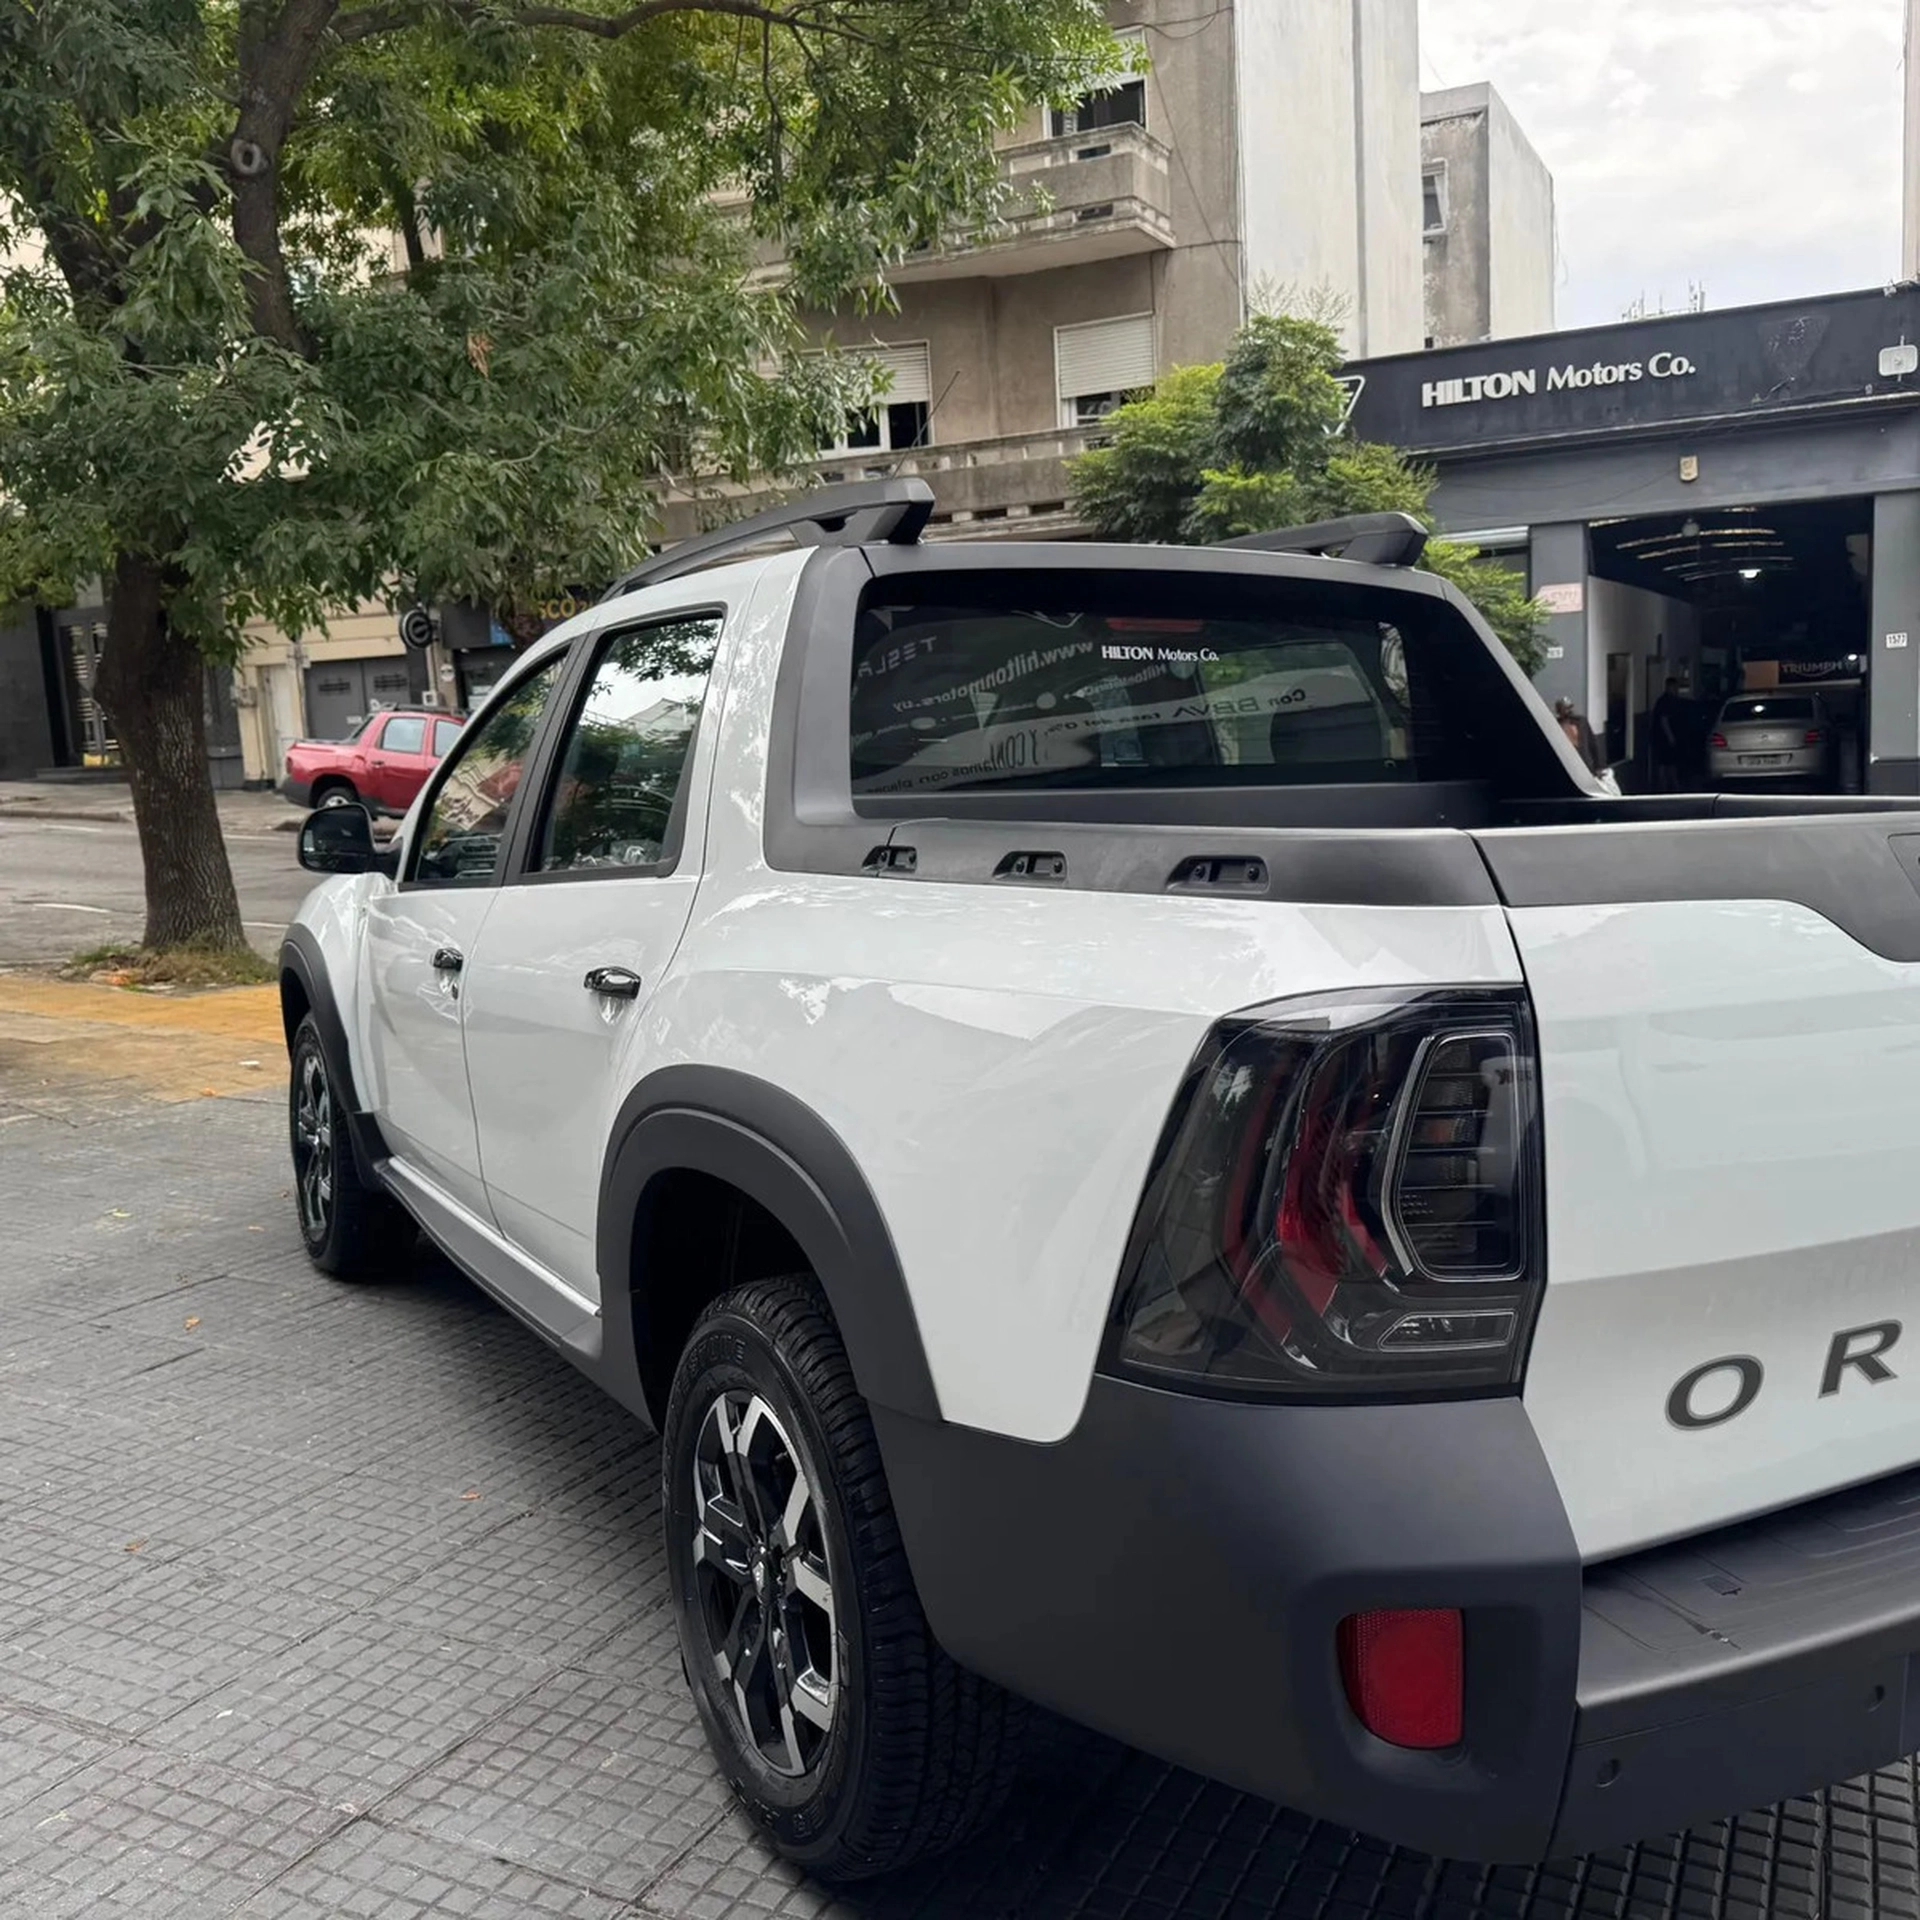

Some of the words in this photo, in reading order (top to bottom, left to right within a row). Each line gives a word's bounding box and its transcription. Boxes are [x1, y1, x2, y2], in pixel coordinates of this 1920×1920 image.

[1422, 369, 1536, 407] HILTON
[1546, 354, 1642, 391] Motors
[1648, 352, 1696, 378] Co.
[1101, 645, 1154, 660] HILTON
[1157, 647, 1198, 662] Motors
[1199, 647, 1220, 662] Co.
